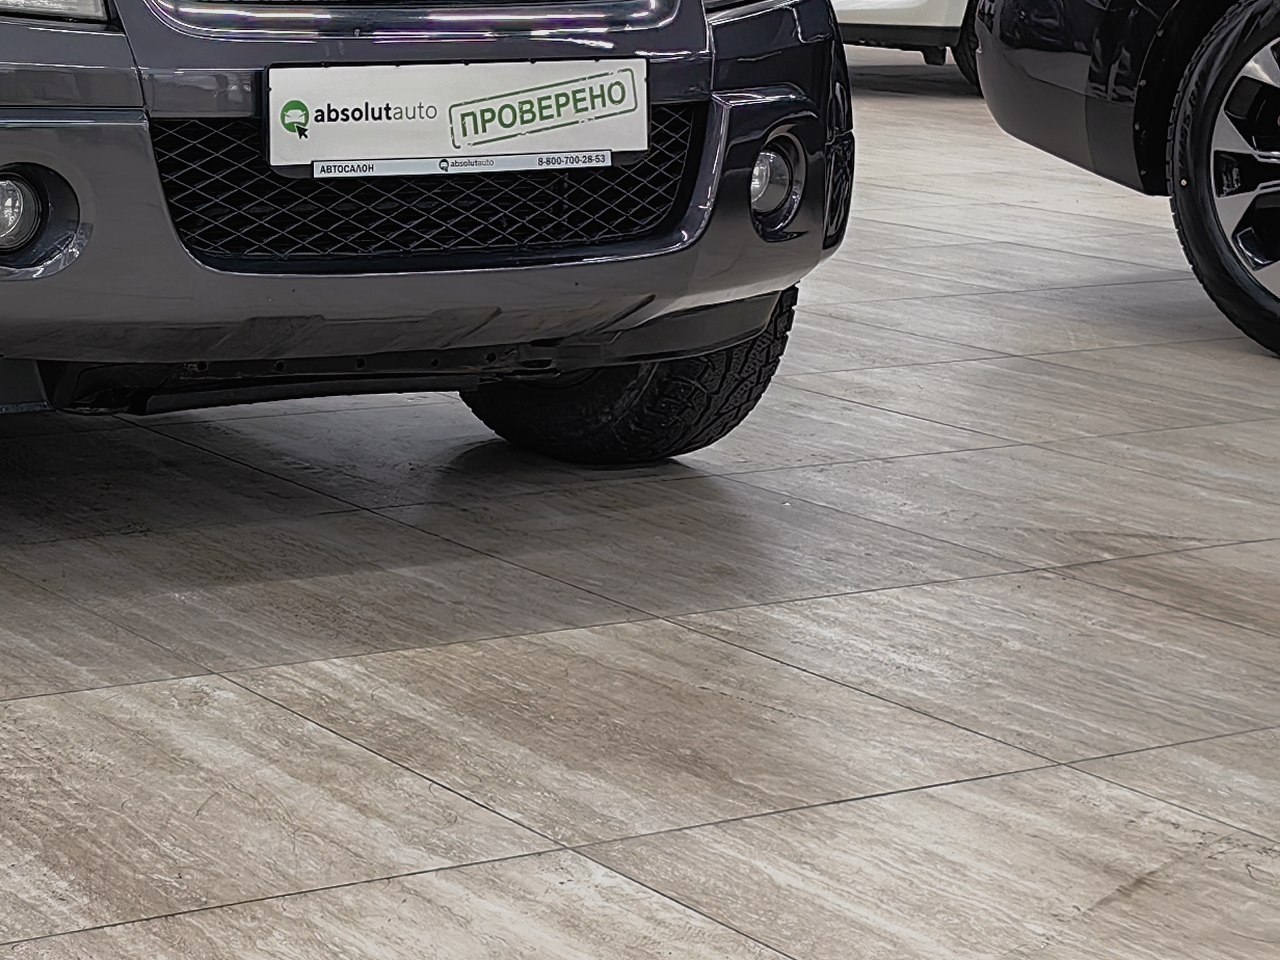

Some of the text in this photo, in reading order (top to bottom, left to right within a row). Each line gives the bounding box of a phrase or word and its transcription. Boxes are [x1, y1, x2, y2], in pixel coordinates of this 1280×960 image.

[313, 101, 438, 124] absolutauto
[460, 80, 627, 138] ПРОВЕРЕНО
[319, 163, 375, 174] АВТОСАЛОН
[450, 158, 495, 169] absolutauto
